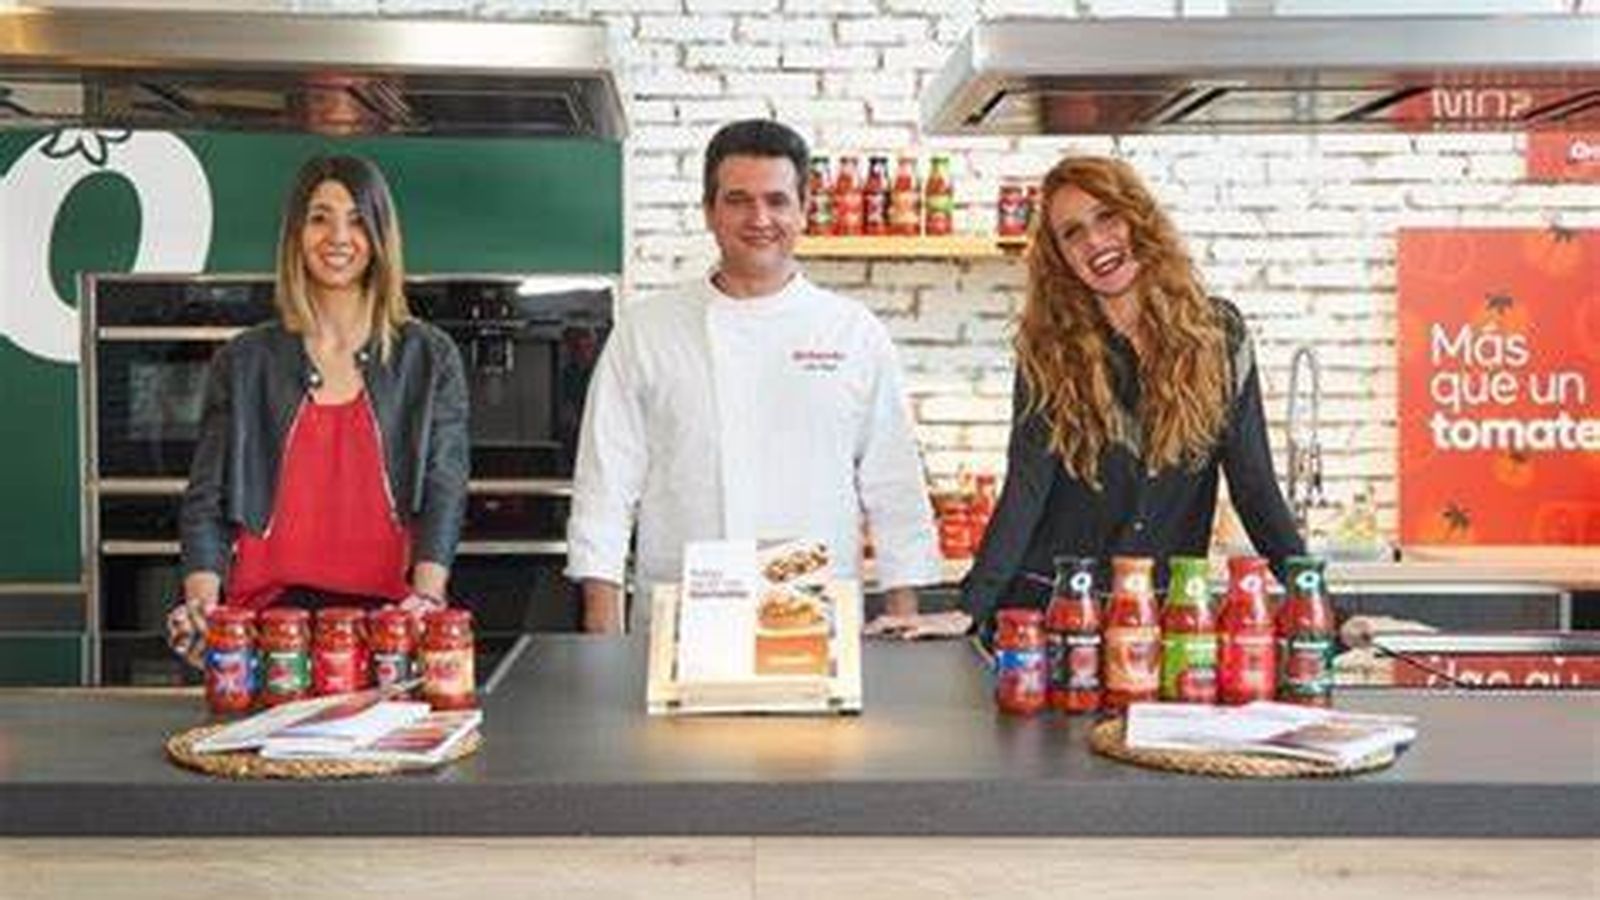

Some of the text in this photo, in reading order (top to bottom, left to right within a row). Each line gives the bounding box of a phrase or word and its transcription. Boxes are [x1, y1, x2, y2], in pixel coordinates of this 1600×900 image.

[1430, 322, 1529, 367] Más
[1430, 371, 1585, 413] que un
[1430, 411, 1600, 450] tomate
